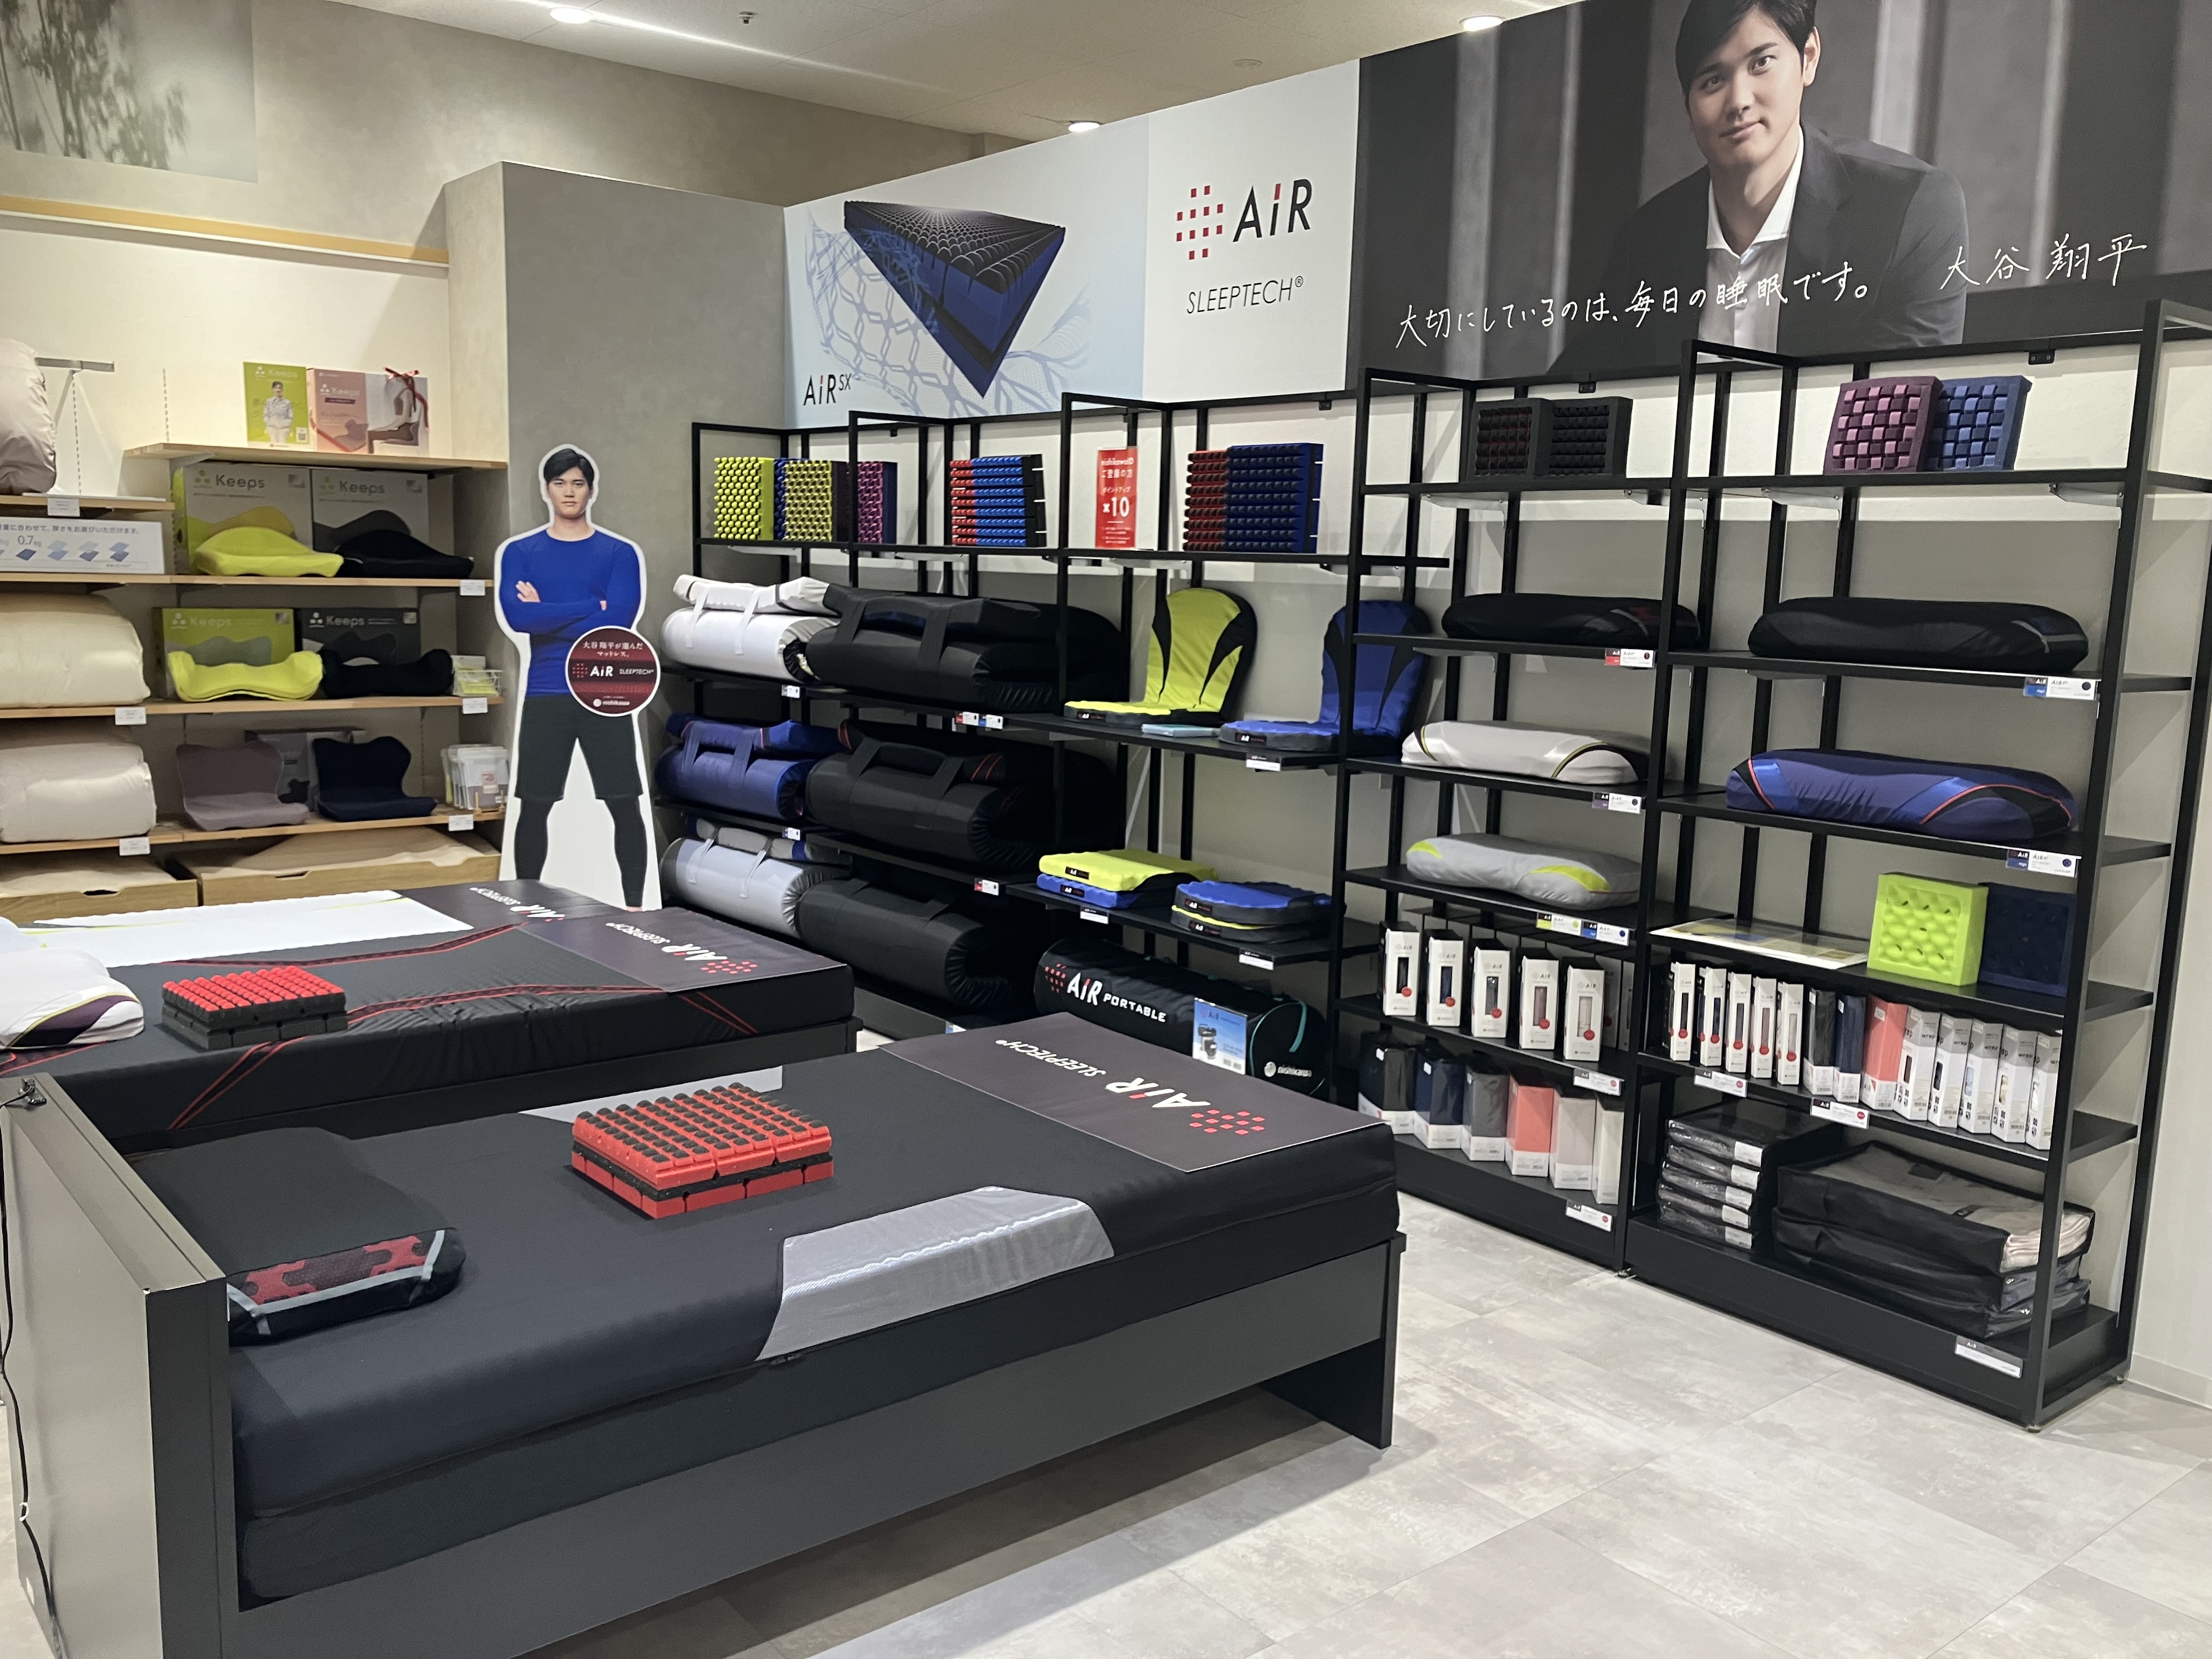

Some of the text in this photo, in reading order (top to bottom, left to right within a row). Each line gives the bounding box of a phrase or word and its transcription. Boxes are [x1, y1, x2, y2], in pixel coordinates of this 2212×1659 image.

[1396, 261, 1869, 350] 大切にしているのは、毎日の睡眠です。
[216, 475, 265, 491] Keeps
[338, 480, 386, 496] Keeps
[326, 615, 365, 628] Keeps
[1103, 992, 1166, 1023] PORTABLE
